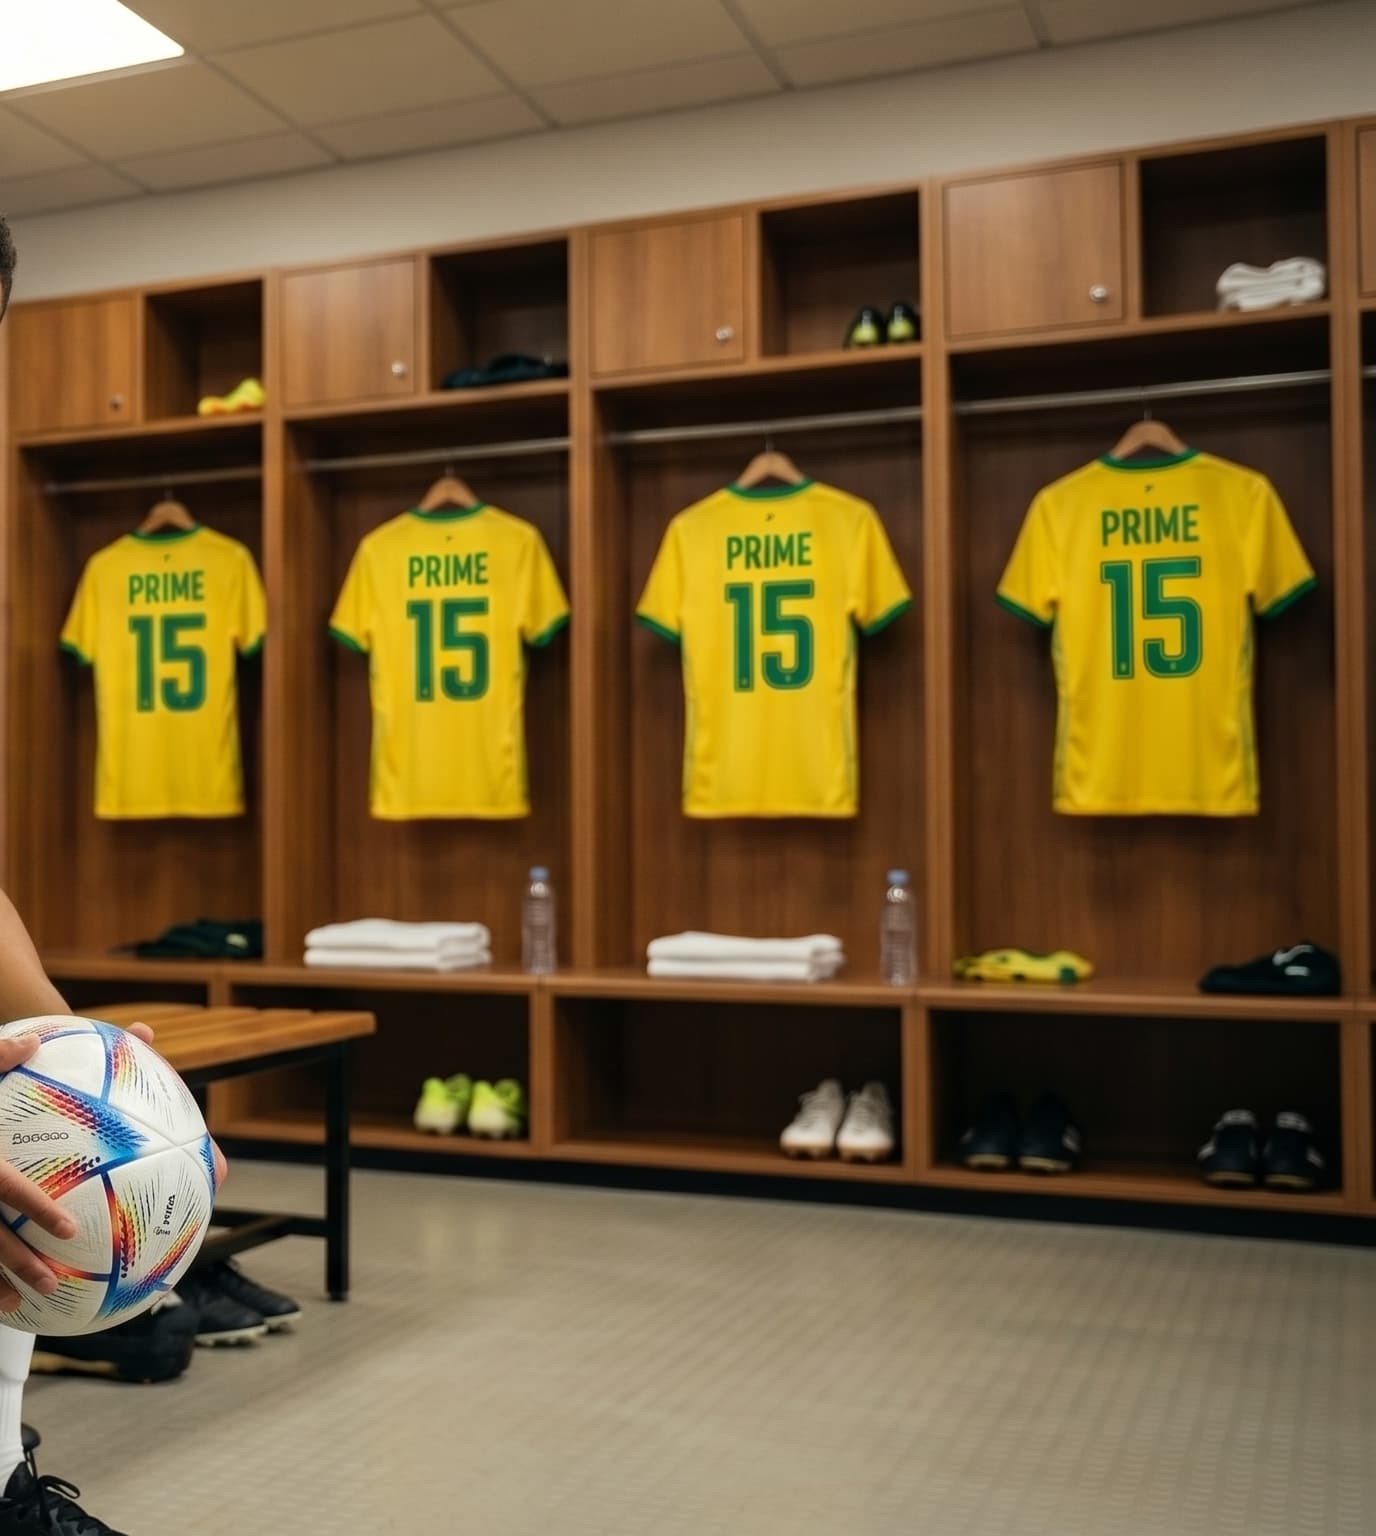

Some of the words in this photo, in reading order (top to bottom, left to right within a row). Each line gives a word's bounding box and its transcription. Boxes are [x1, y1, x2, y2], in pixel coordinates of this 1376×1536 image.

[726, 531, 813, 571] PRIME
[1101, 504, 1200, 547] PRIME
[128, 569, 205, 605] PRIME
[408, 551, 490, 588] PRIME
[406, 596, 490, 703] 15
[725, 578, 814, 692] 15
[1099, 555, 1203, 680] 15
[128, 611, 207, 713] 15
